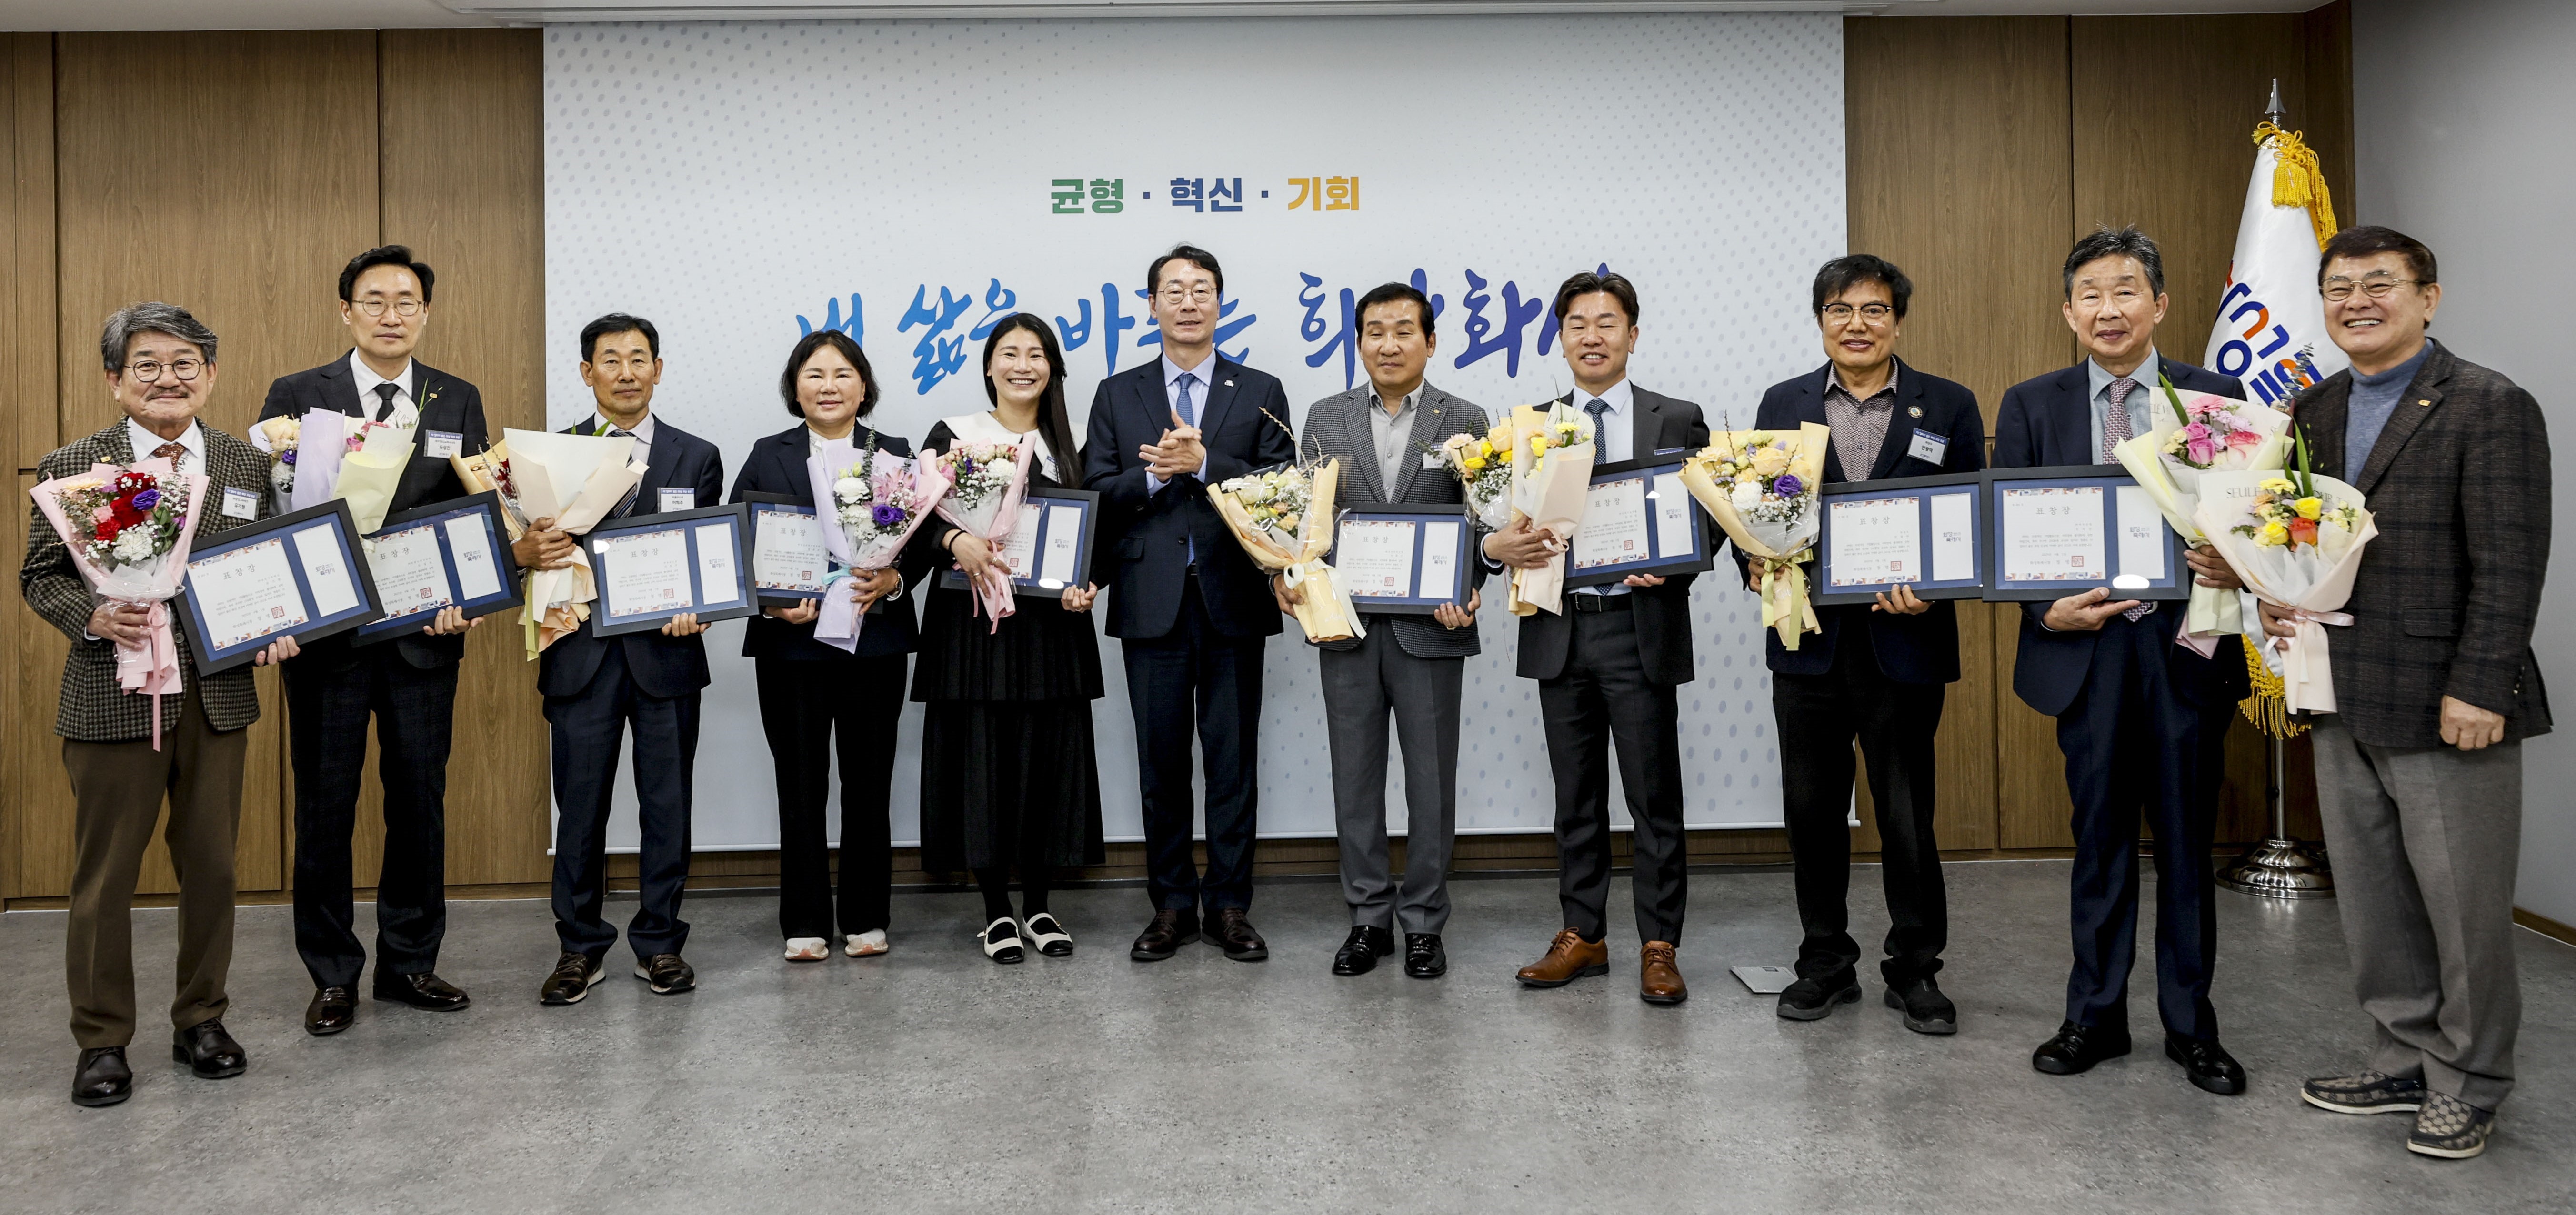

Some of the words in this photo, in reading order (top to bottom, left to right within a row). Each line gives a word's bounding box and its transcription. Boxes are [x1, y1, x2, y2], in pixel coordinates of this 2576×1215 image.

[1051, 178, 1123, 214] 균형
[1170, 177, 1243, 213] 혁신
[1287, 175, 1360, 212] 기회
